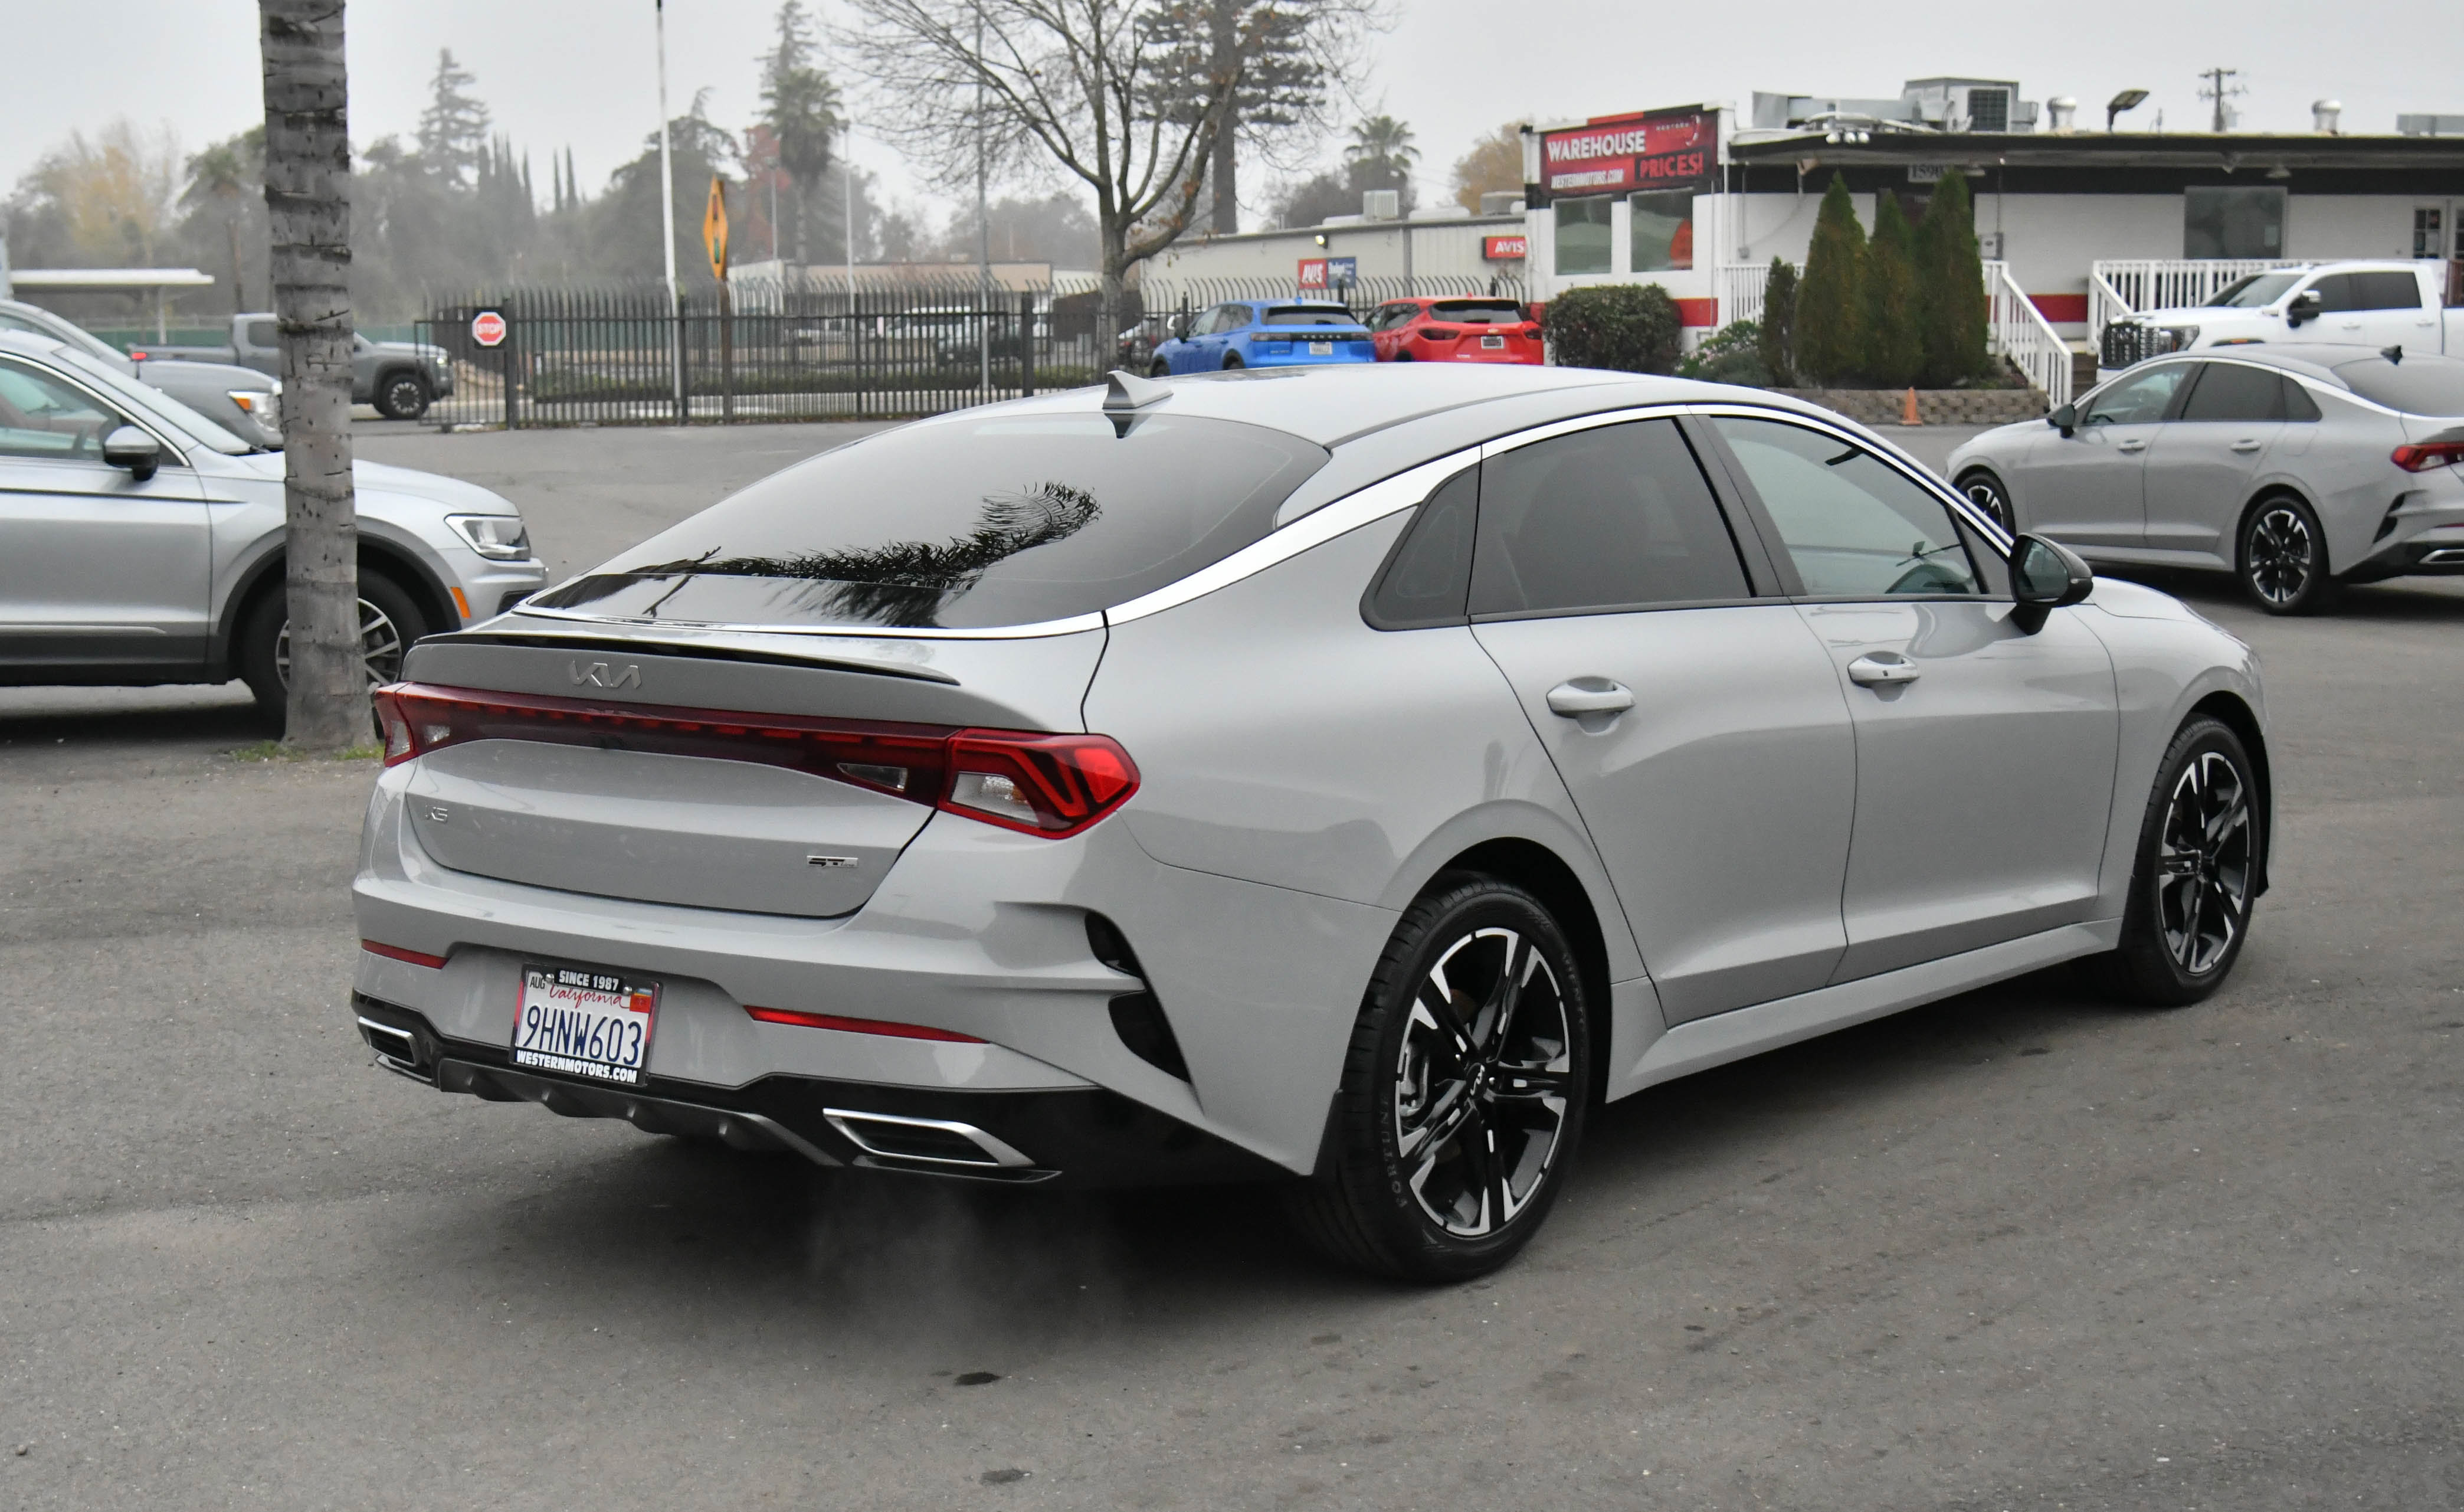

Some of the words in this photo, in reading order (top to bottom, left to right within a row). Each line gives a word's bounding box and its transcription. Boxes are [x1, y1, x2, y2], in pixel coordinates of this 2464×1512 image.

[1546, 130, 1646, 163] WAREHOUSE
[1639, 152, 1704, 179] PRICES!
[1495, 240, 1525, 254] AVIS
[1302, 263, 1323, 284] AVIS
[476, 322, 503, 335] STOP
[425, 804, 448, 823] K5
[529, 976, 546, 989] AUG
[558, 970, 590, 987] SINCE
[592, 974, 620, 991] 1987
[549, 984, 630, 1009] California
[523, 1005, 643, 1066] 9HNW603
[516, 1049, 638, 1084] WESTERNMOTORS.COM
